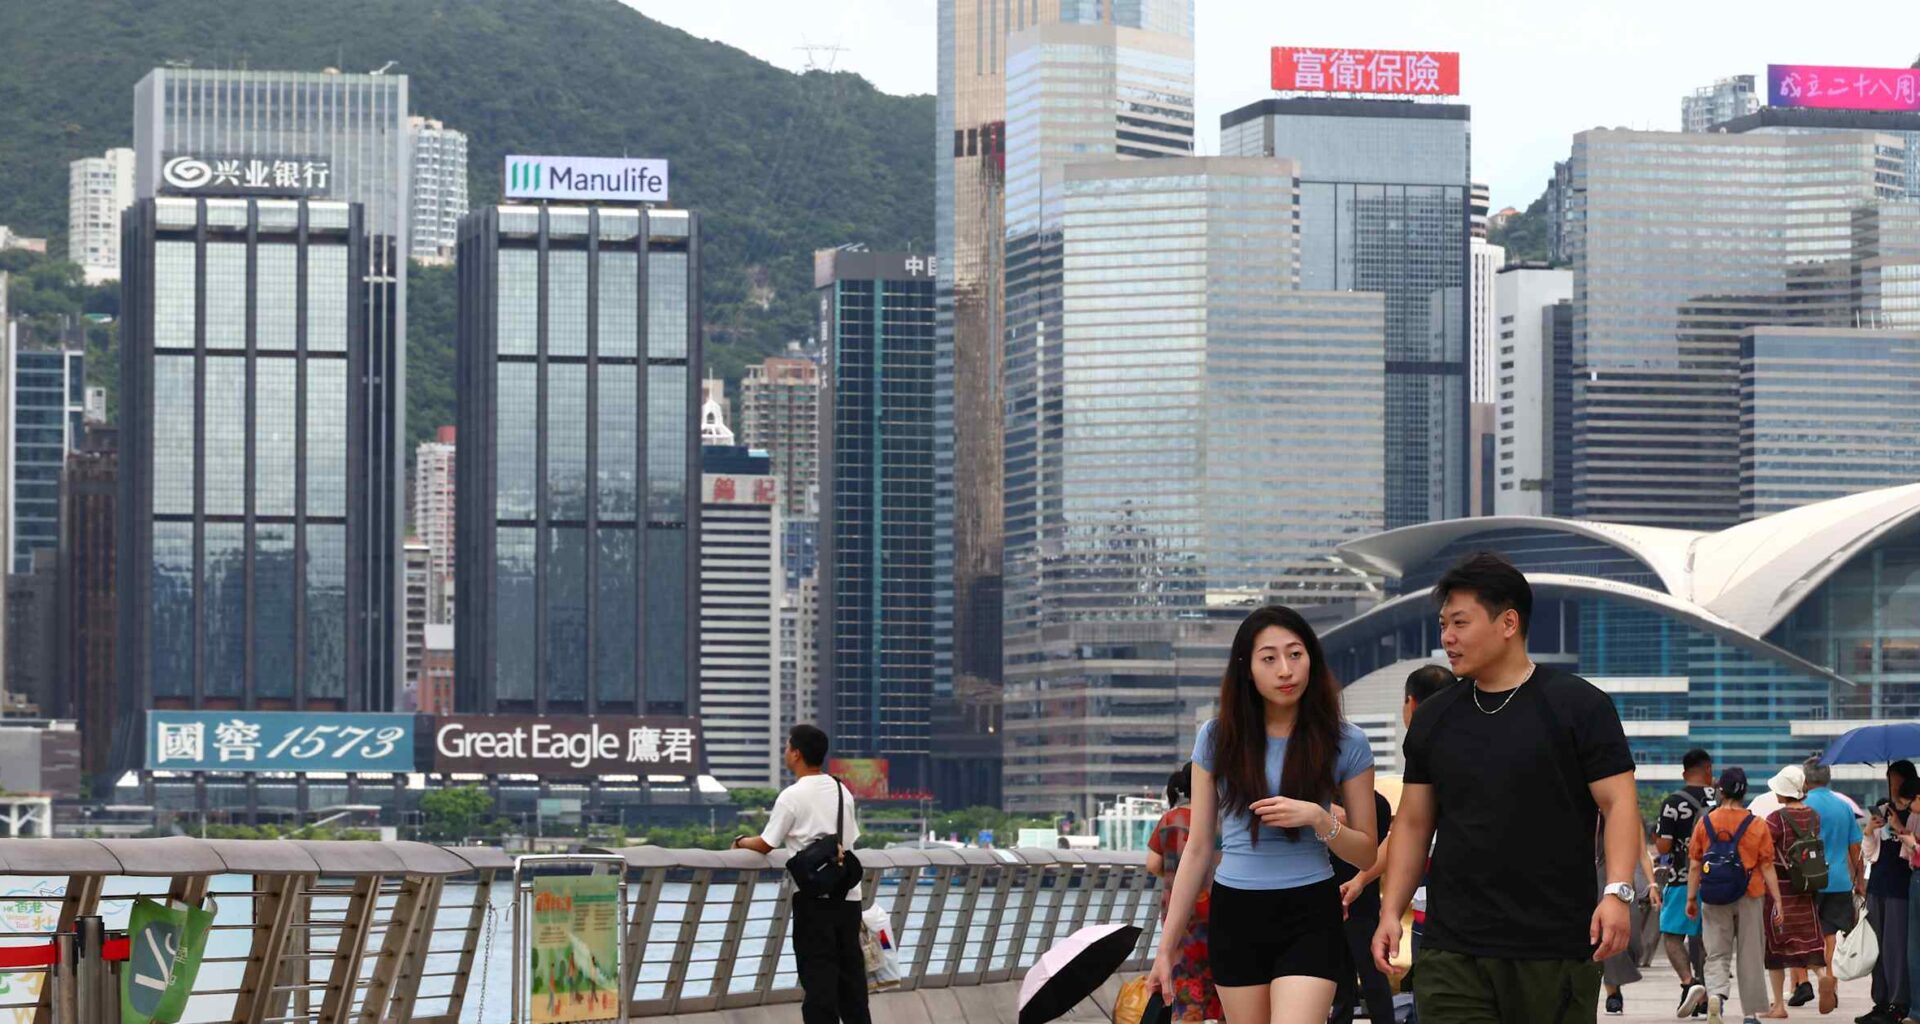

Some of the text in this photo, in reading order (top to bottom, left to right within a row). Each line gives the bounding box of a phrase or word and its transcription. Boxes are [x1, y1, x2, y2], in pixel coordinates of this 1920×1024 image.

[1293, 51, 1440, 91] 富衛保險
[1780, 72, 1920, 104] 成立二十八周
[213, 159, 330, 189] 兴业银行
[550, 166, 662, 193] Manulife
[157, 719, 405, 763] 國窖 1573
[436, 724, 696, 768] Great Eagle 鷹君
